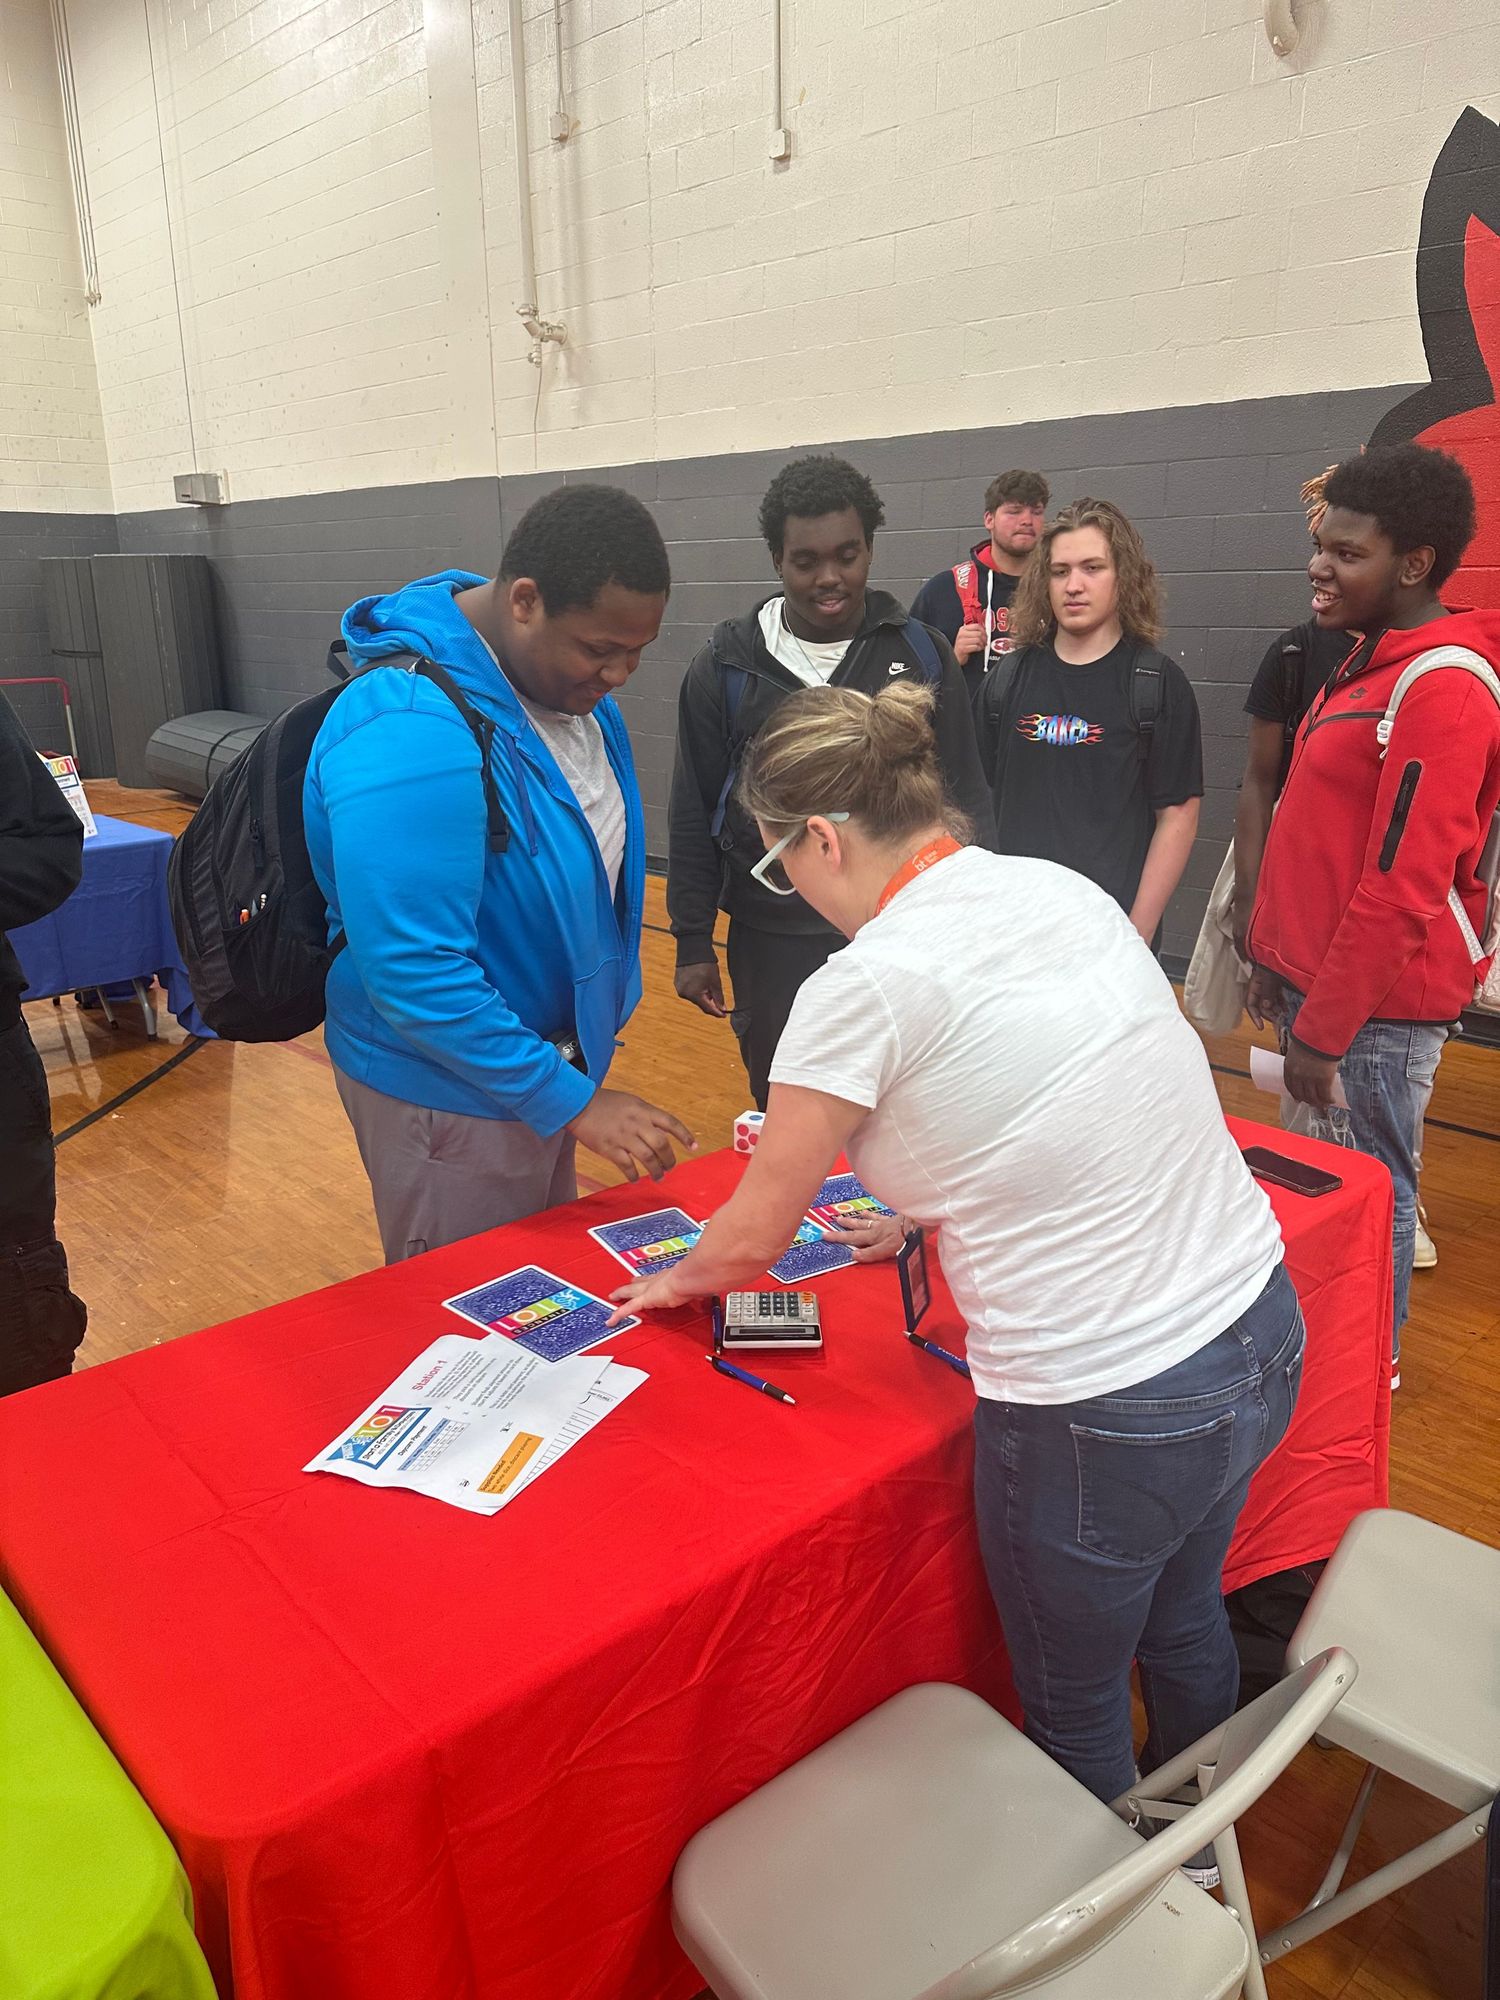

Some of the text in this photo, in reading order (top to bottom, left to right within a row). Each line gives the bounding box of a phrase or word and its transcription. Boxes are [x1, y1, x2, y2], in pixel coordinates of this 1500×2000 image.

[1036, 714, 1089, 746] BAKER
[627, 1240, 683, 1260] 101
[496, 1303, 561, 1331] 101
[513, 1308, 569, 1335] FINANCES
[412, 1365, 443, 1391] Station
[358, 1408, 404, 1436] 101
